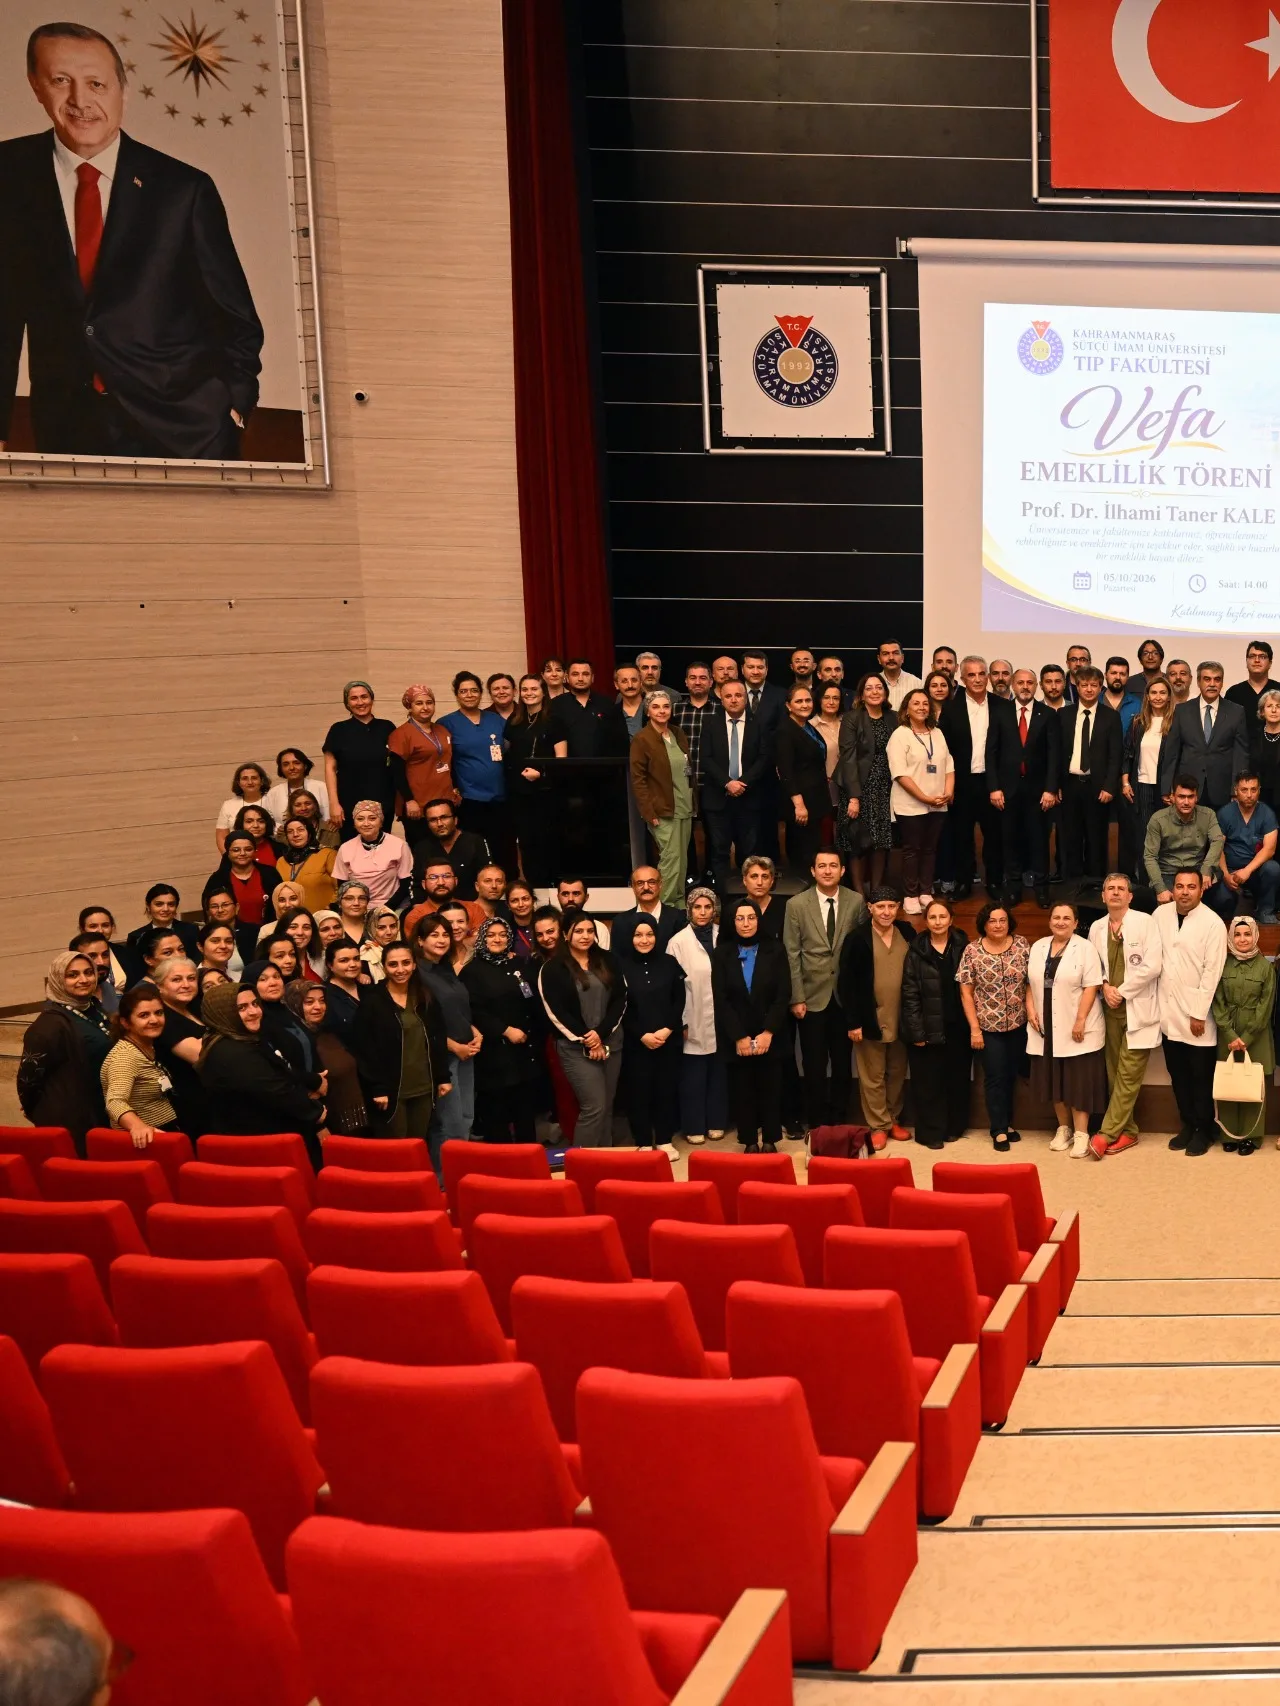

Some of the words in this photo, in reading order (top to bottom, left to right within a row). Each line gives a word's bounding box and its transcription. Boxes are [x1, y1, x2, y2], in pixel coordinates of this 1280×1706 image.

[787, 323, 802, 331] T.C.
[1072, 328, 1176, 342] KAHRAMANMARAŞ
[1072, 340, 1109, 353] SÜTÇÜ
[1114, 340, 1144, 353] İMAM
[1148, 341, 1227, 356] ÜNİVERSİTESİ
[781, 362, 811, 370] 1992
[1073, 356, 1104, 372] TIP
[1109, 355, 1211, 376] FAKÜLTESİ
[1059, 384, 1226, 460] Vefa
[1020, 459, 1167, 486] EMEKLİLİK
[1173, 462, 1273, 489] TÖRENİ
[1021, 501, 1065, 518] Prof.
[1070, 502, 1098, 519] Dr.
[1104, 500, 1161, 520] İlhami
[1165, 505, 1218, 522] Taner
[1222, 507, 1276, 524] KALE
[1103, 573, 1156, 583] 05/10/2026
[1218, 579, 1240, 589] Saat:
[1244, 580, 1268, 589] 14.00
[1103, 583, 1136, 593] Pazartesi
